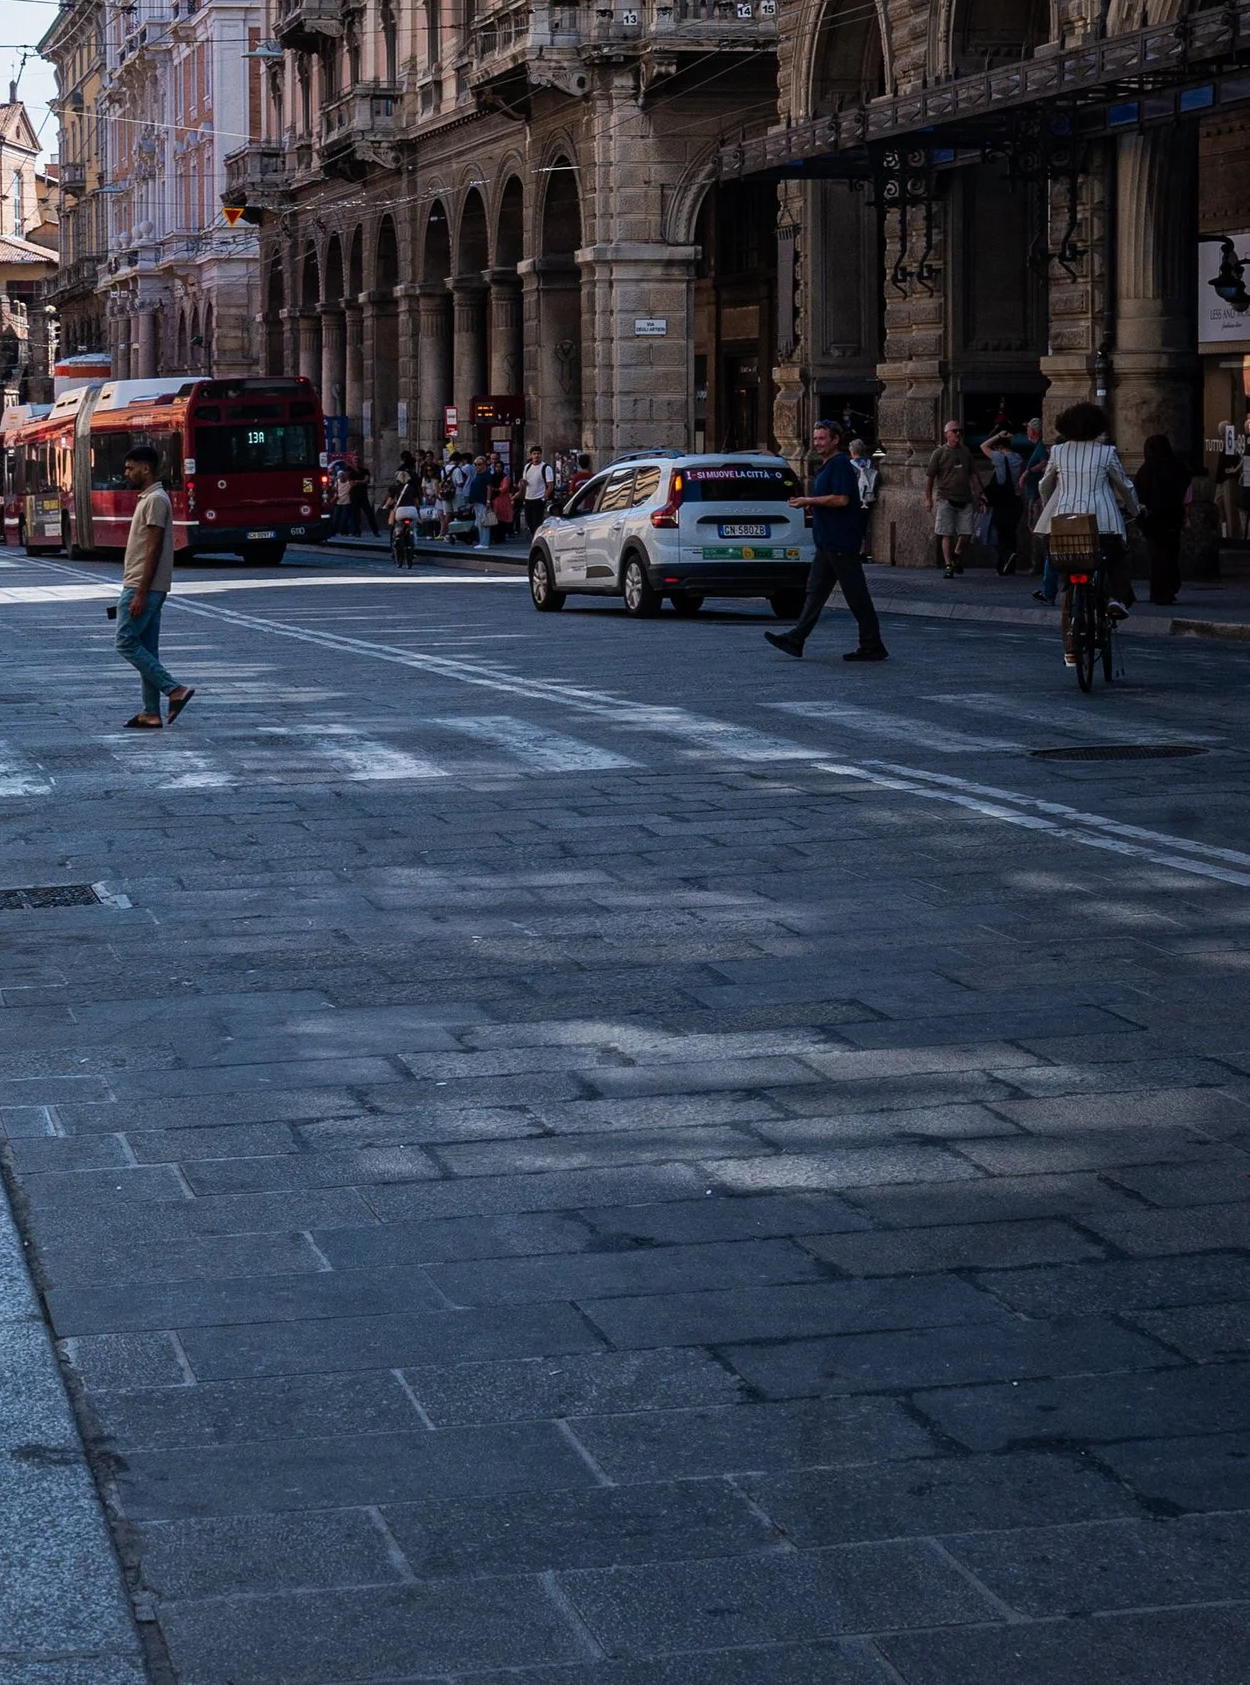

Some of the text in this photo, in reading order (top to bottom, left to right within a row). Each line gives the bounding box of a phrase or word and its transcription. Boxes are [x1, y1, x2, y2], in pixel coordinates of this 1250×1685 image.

[738, 6, 751, 15] 14
[763, 4, 774, 13] 15
[624, 15, 637, 24] 13
[248, 431, 265, 444] 13A
[1205, 438, 1224, 452] TUTTO
[697, 471, 706, 479] SI
[706, 470, 735, 479] MUOVE
[746, 469, 770, 479] CITTÀ
